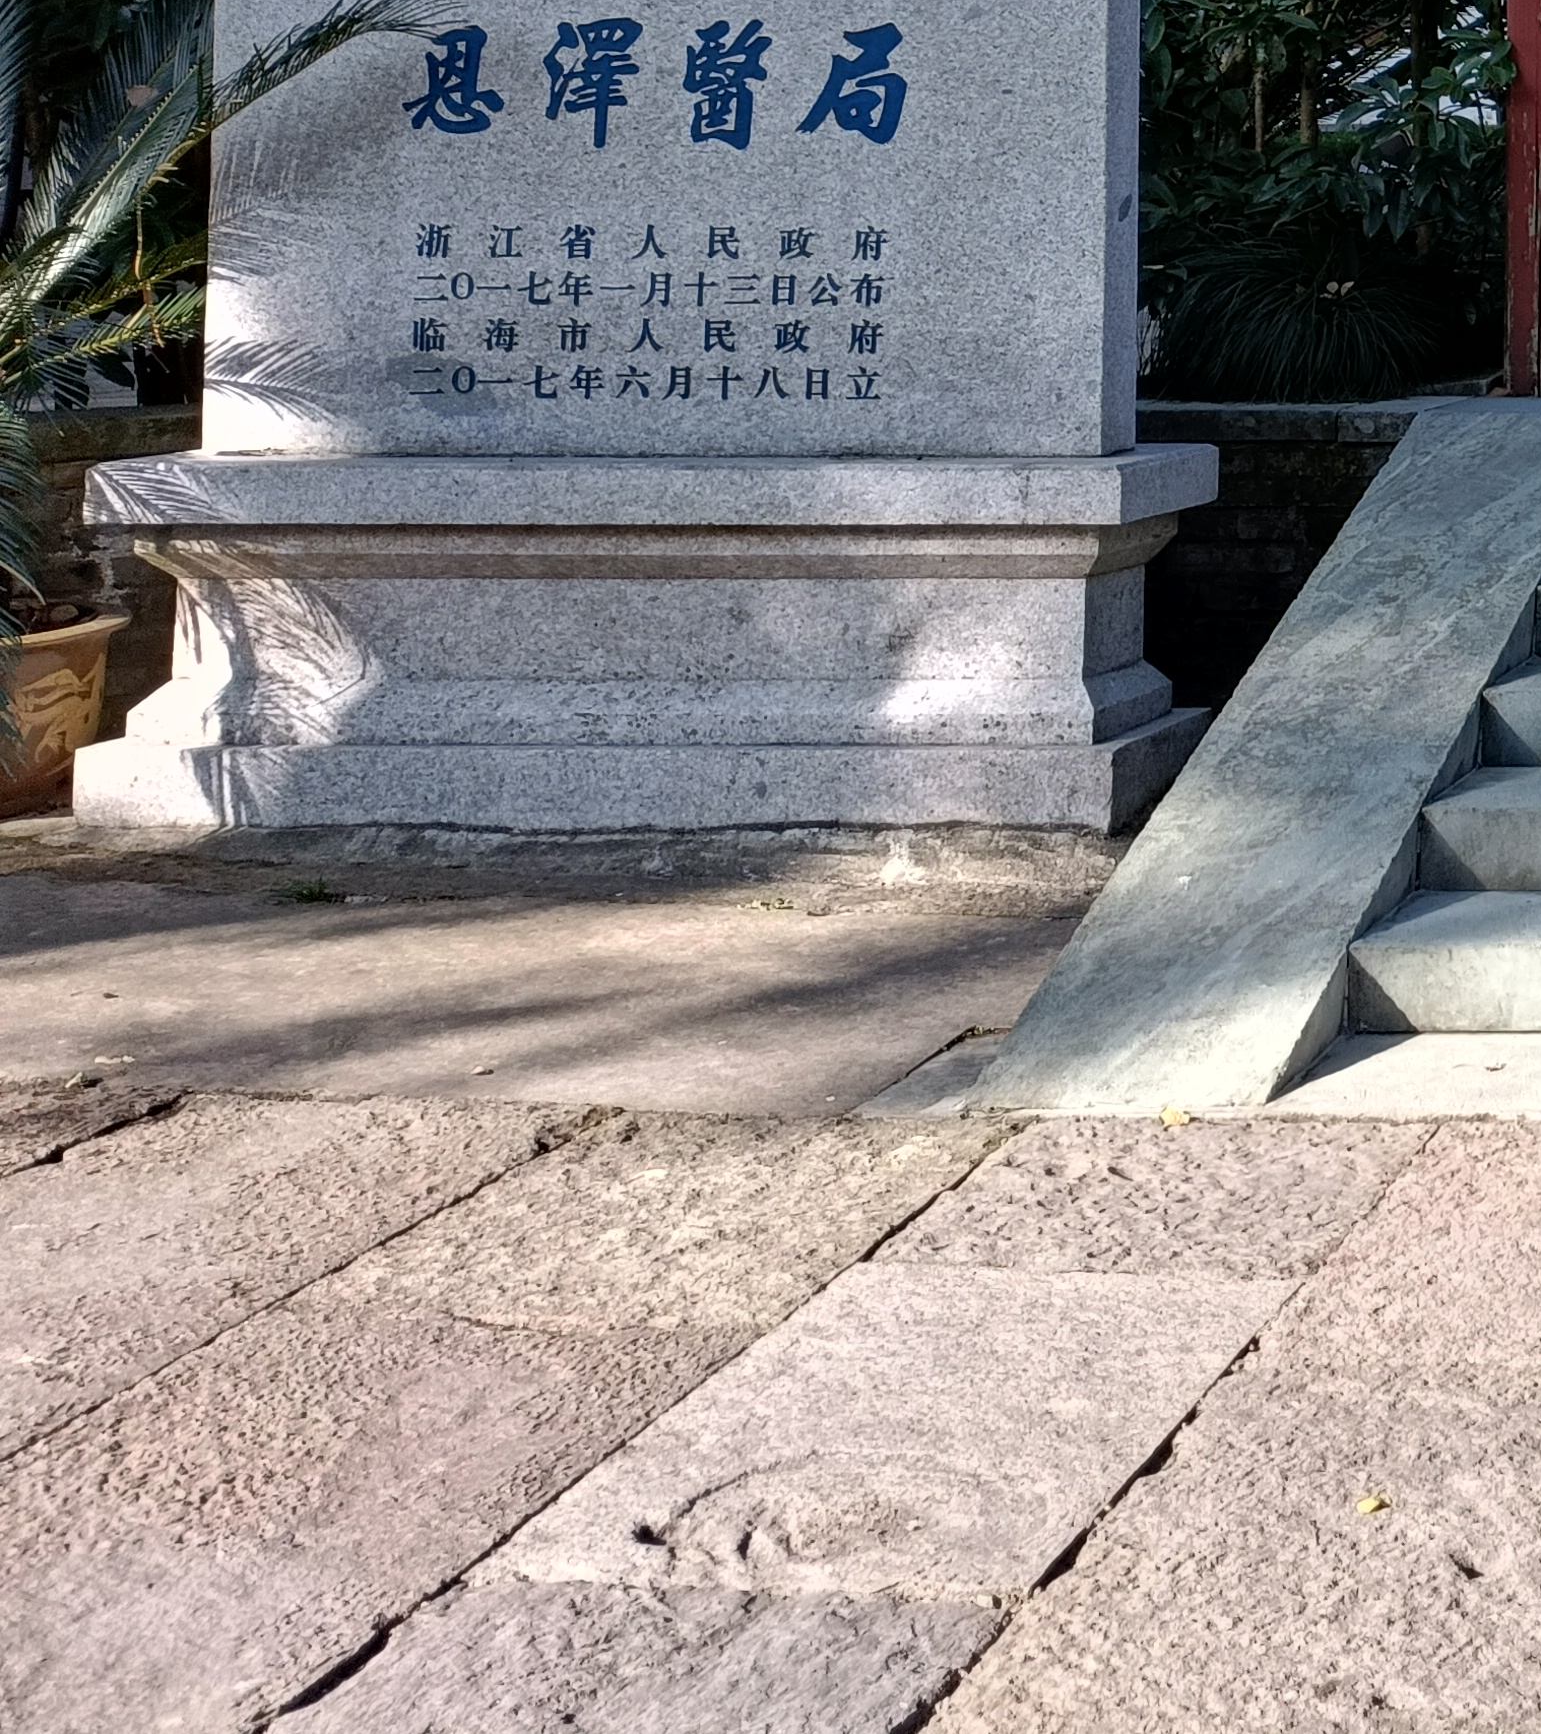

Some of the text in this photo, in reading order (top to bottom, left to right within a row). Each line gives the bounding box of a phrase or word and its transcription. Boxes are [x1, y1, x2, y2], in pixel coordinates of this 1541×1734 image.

[414, 223, 889, 261] 浙江省人民政府
[411, 318, 885, 355] 临海市人民政府
